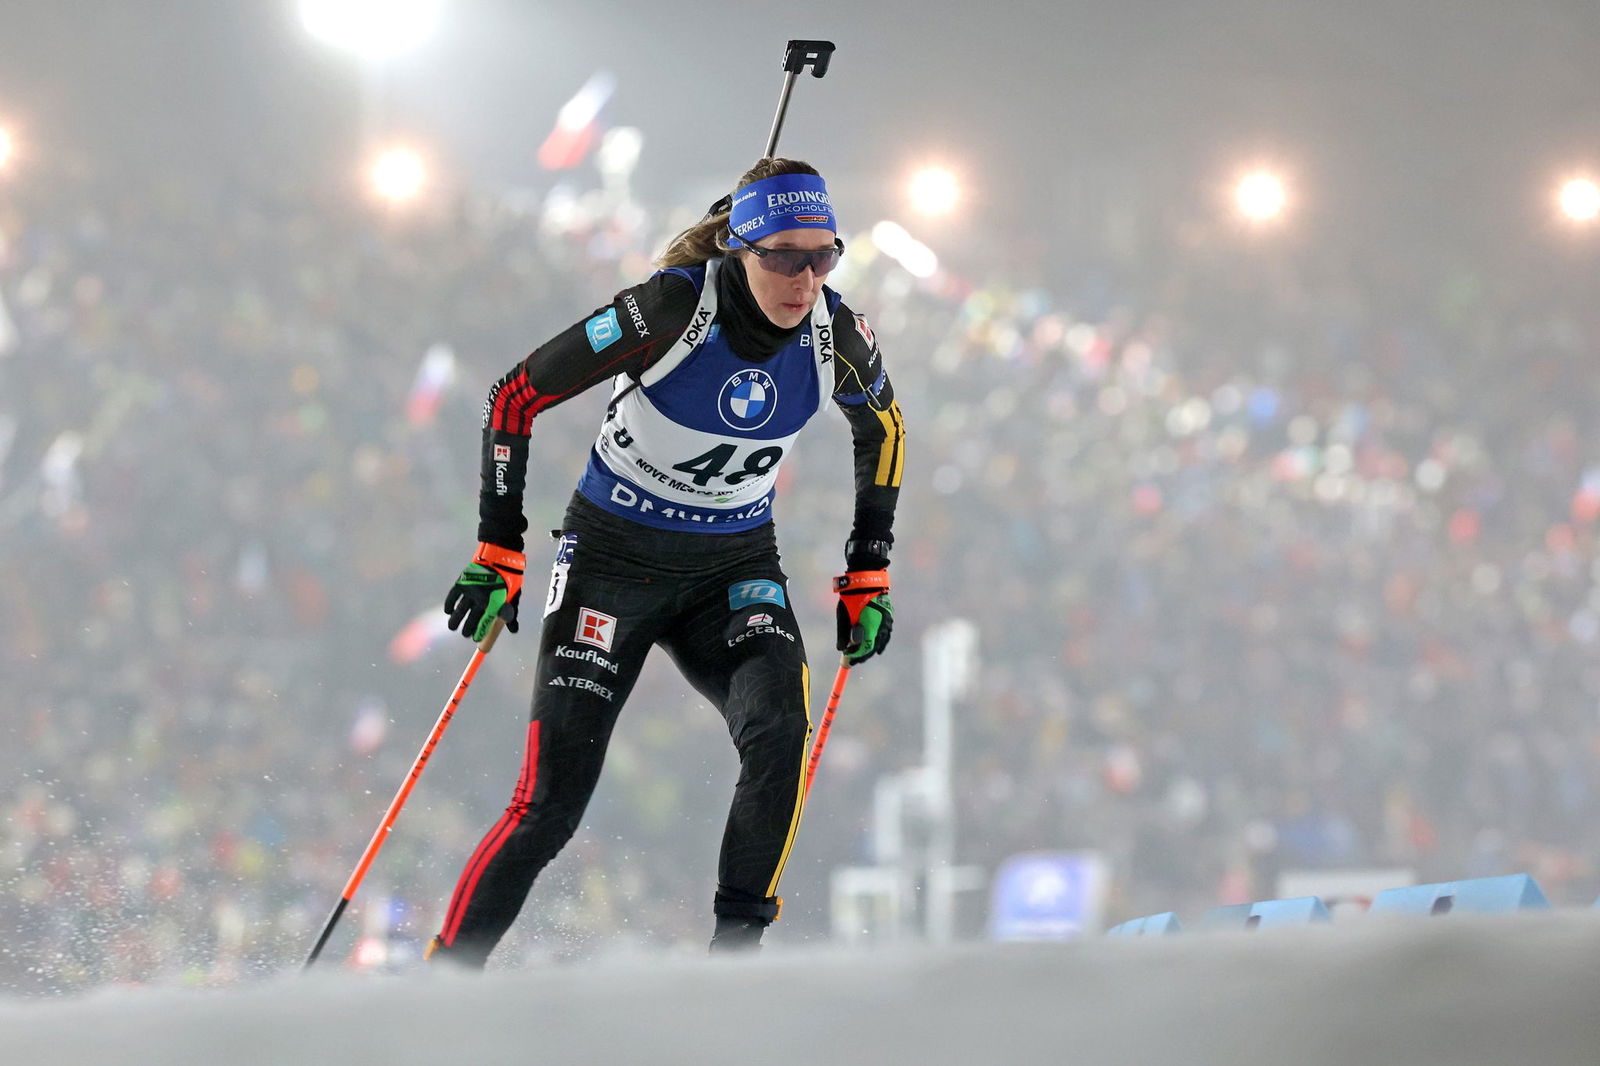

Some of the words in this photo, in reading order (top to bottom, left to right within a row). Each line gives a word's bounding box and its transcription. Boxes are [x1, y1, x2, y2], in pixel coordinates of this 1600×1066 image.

[682, 310, 712, 349] JOKA
[816, 324, 833, 364] JOKA
[731, 372, 771, 390] BMW
[635, 458, 672, 484] NOVE
[672, 443, 784, 487] 48
[727, 625, 795, 648] tectake
[555, 645, 619, 675] Kaufland
[567, 676, 614, 702] TERREX
